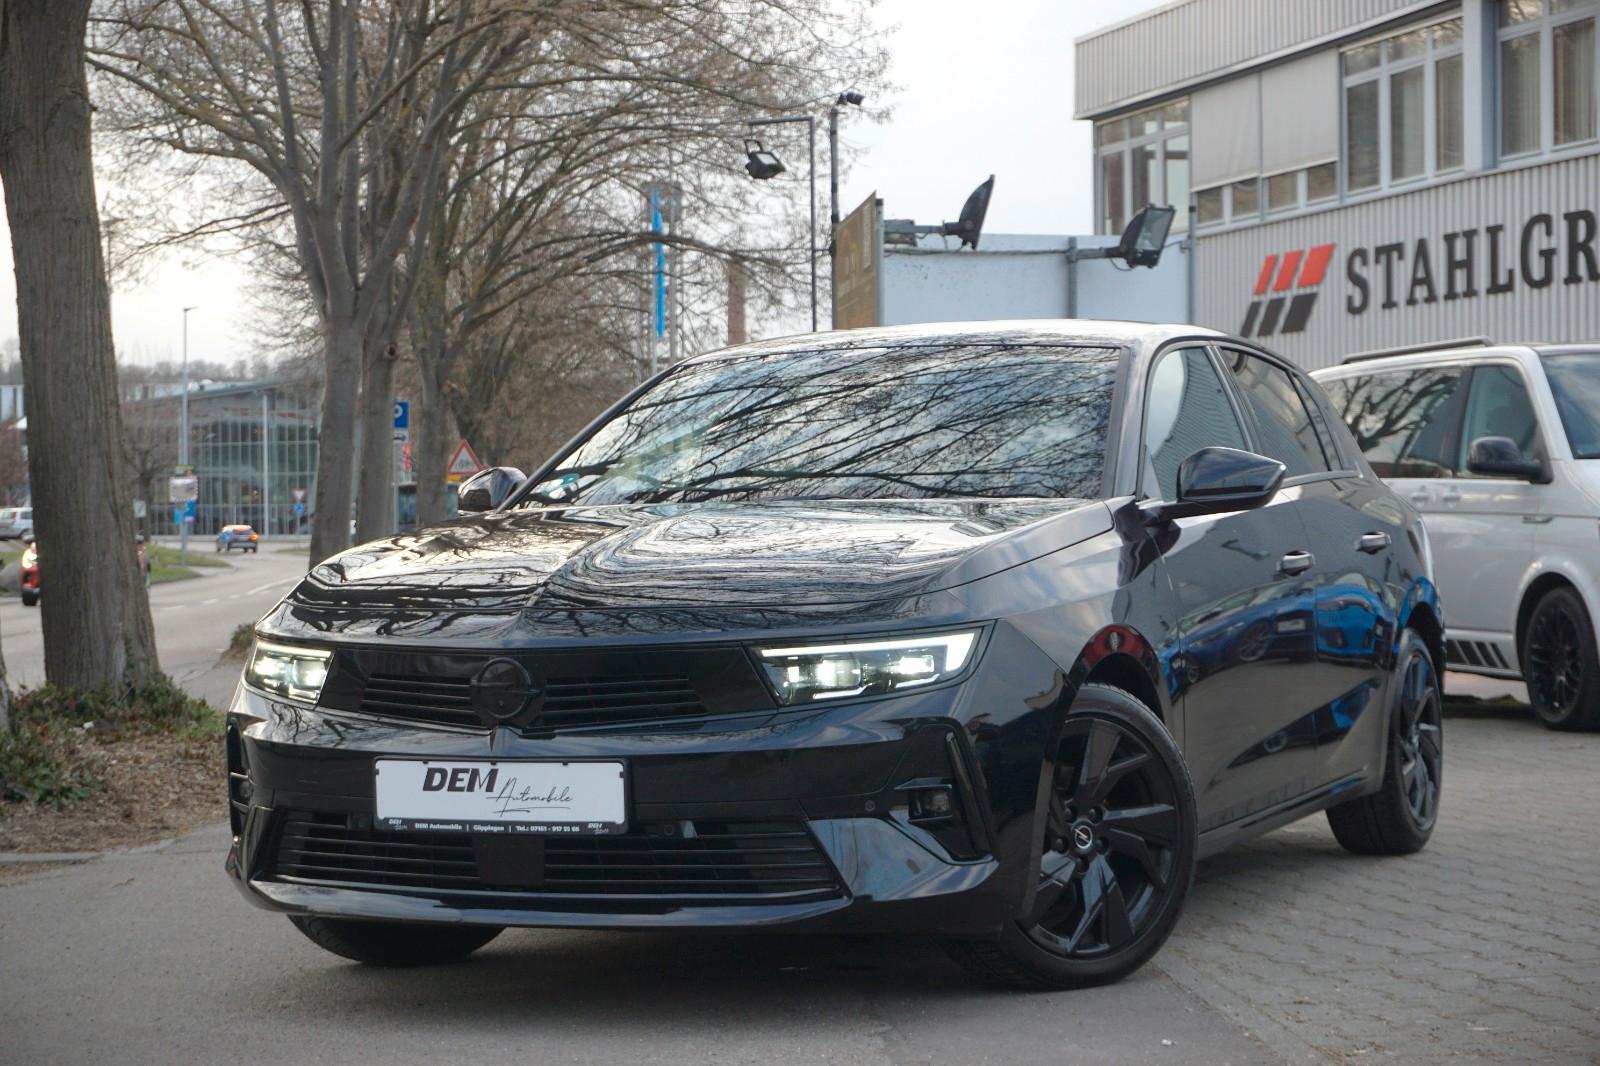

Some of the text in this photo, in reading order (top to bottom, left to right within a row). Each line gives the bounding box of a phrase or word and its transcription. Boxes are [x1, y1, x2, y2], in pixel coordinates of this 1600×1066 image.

[1346, 209, 1600, 316] STAHLGR
[422, 767, 499, 793] DEM
[486, 777, 573, 814] Automobile
[429, 823, 463, 831] Automobile
